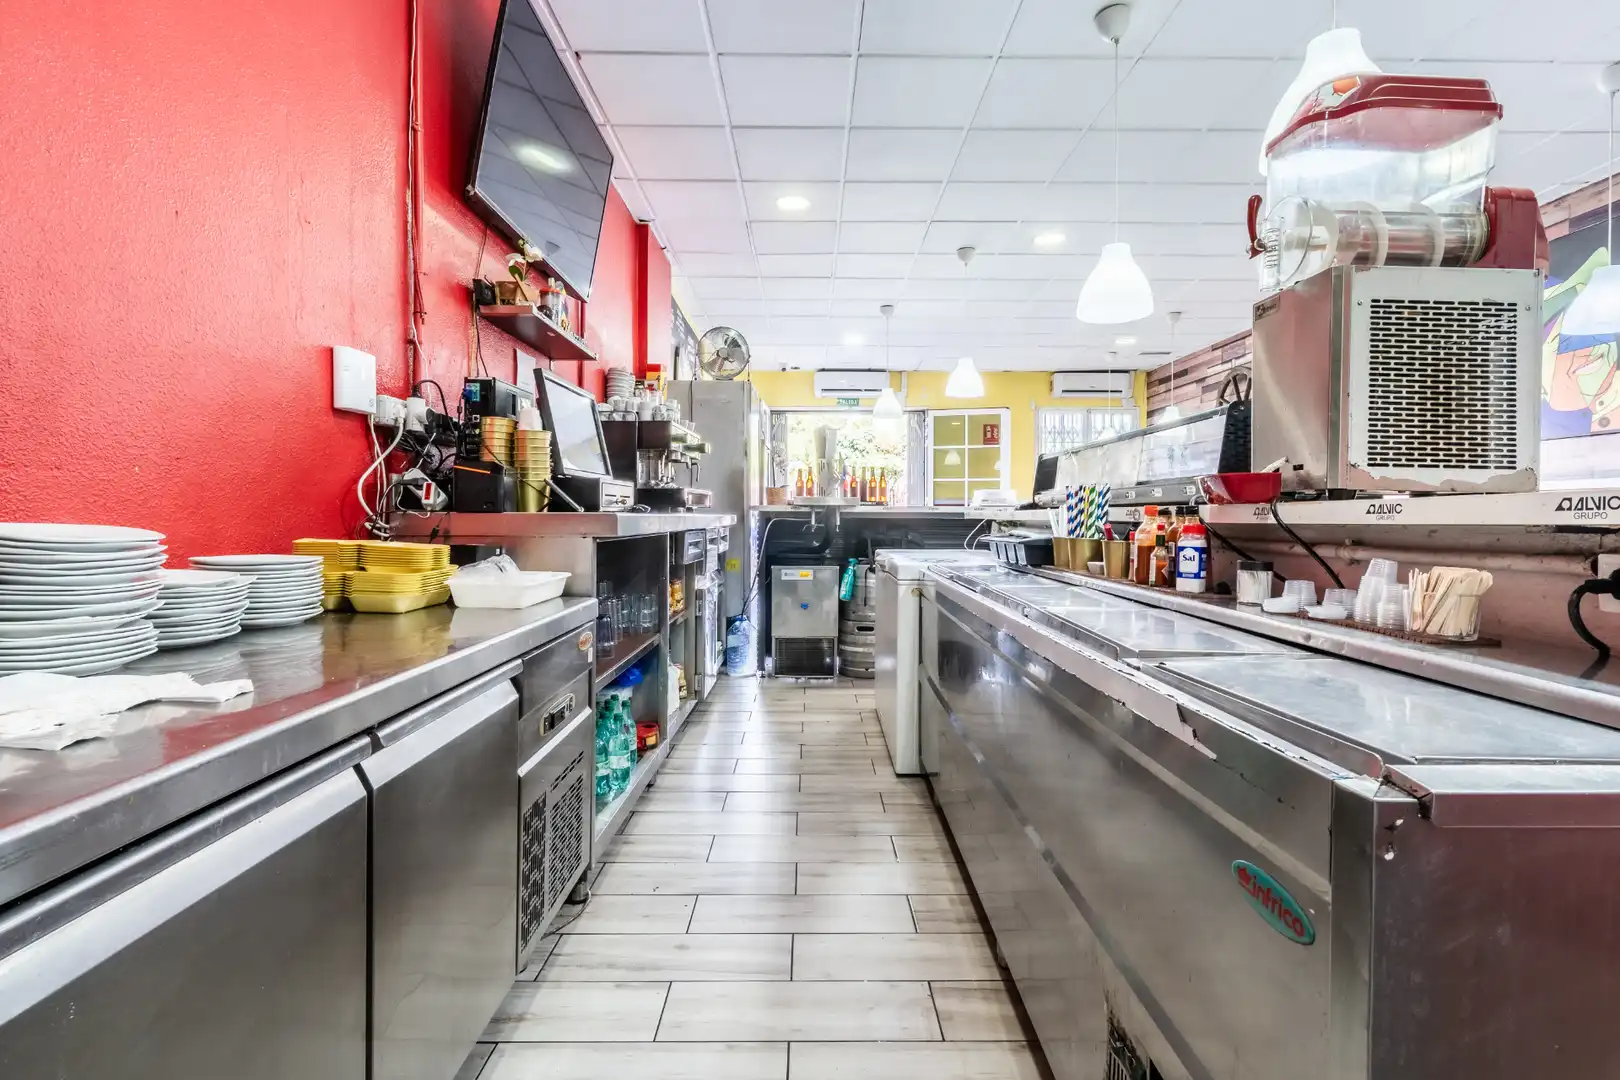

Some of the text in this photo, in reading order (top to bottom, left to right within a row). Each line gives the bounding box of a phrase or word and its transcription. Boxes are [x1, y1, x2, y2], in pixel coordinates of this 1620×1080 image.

[1375, 503, 1403, 515] ALVIC
[1573, 496, 1620, 511] ALVIC
[1573, 511, 1608, 520] GRUPO
[1182, 554, 1196, 562] Sal
[1252, 876, 1305, 938] infrico
